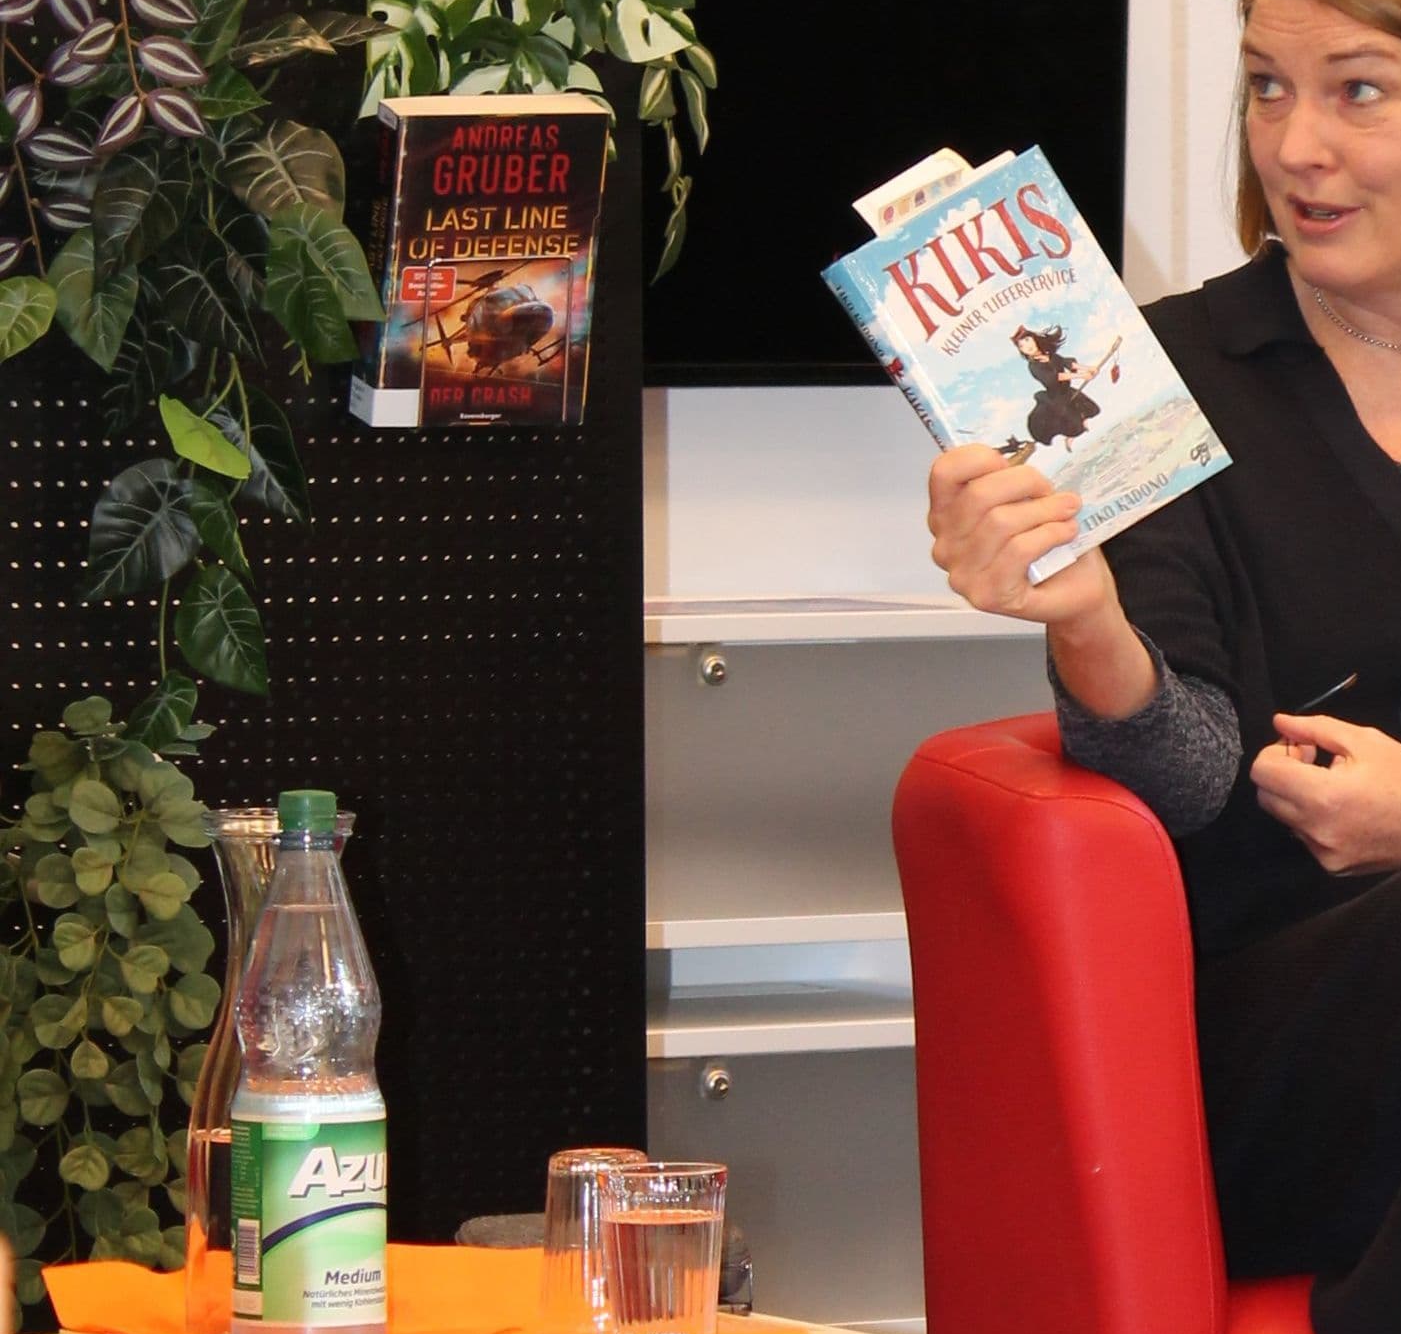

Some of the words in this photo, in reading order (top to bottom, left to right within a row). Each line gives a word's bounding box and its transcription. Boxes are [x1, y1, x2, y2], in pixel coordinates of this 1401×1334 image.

[452, 123, 561, 150] ANDREAS
[433, 152, 571, 196] GRUBER
[425, 206, 498, 232] LAST
[504, 205, 569, 231] LINE
[408, 236, 446, 260] OF
[453, 233, 581, 259] DEFENSE
[882, 182, 1073, 343] KIKIS
[941, 308, 989, 357] KLEINER
[982, 267, 1078, 315] LIEFERSERVICE
[471, 385, 534, 406] CRASH
[1083, 505, 1117, 532] EIKO
[1115, 472, 1170, 513] KADONO
[287, 1145, 387, 1199] AZU
[324, 1268, 382, 1285] Medium
[311, 1300, 327, 1309] mit
